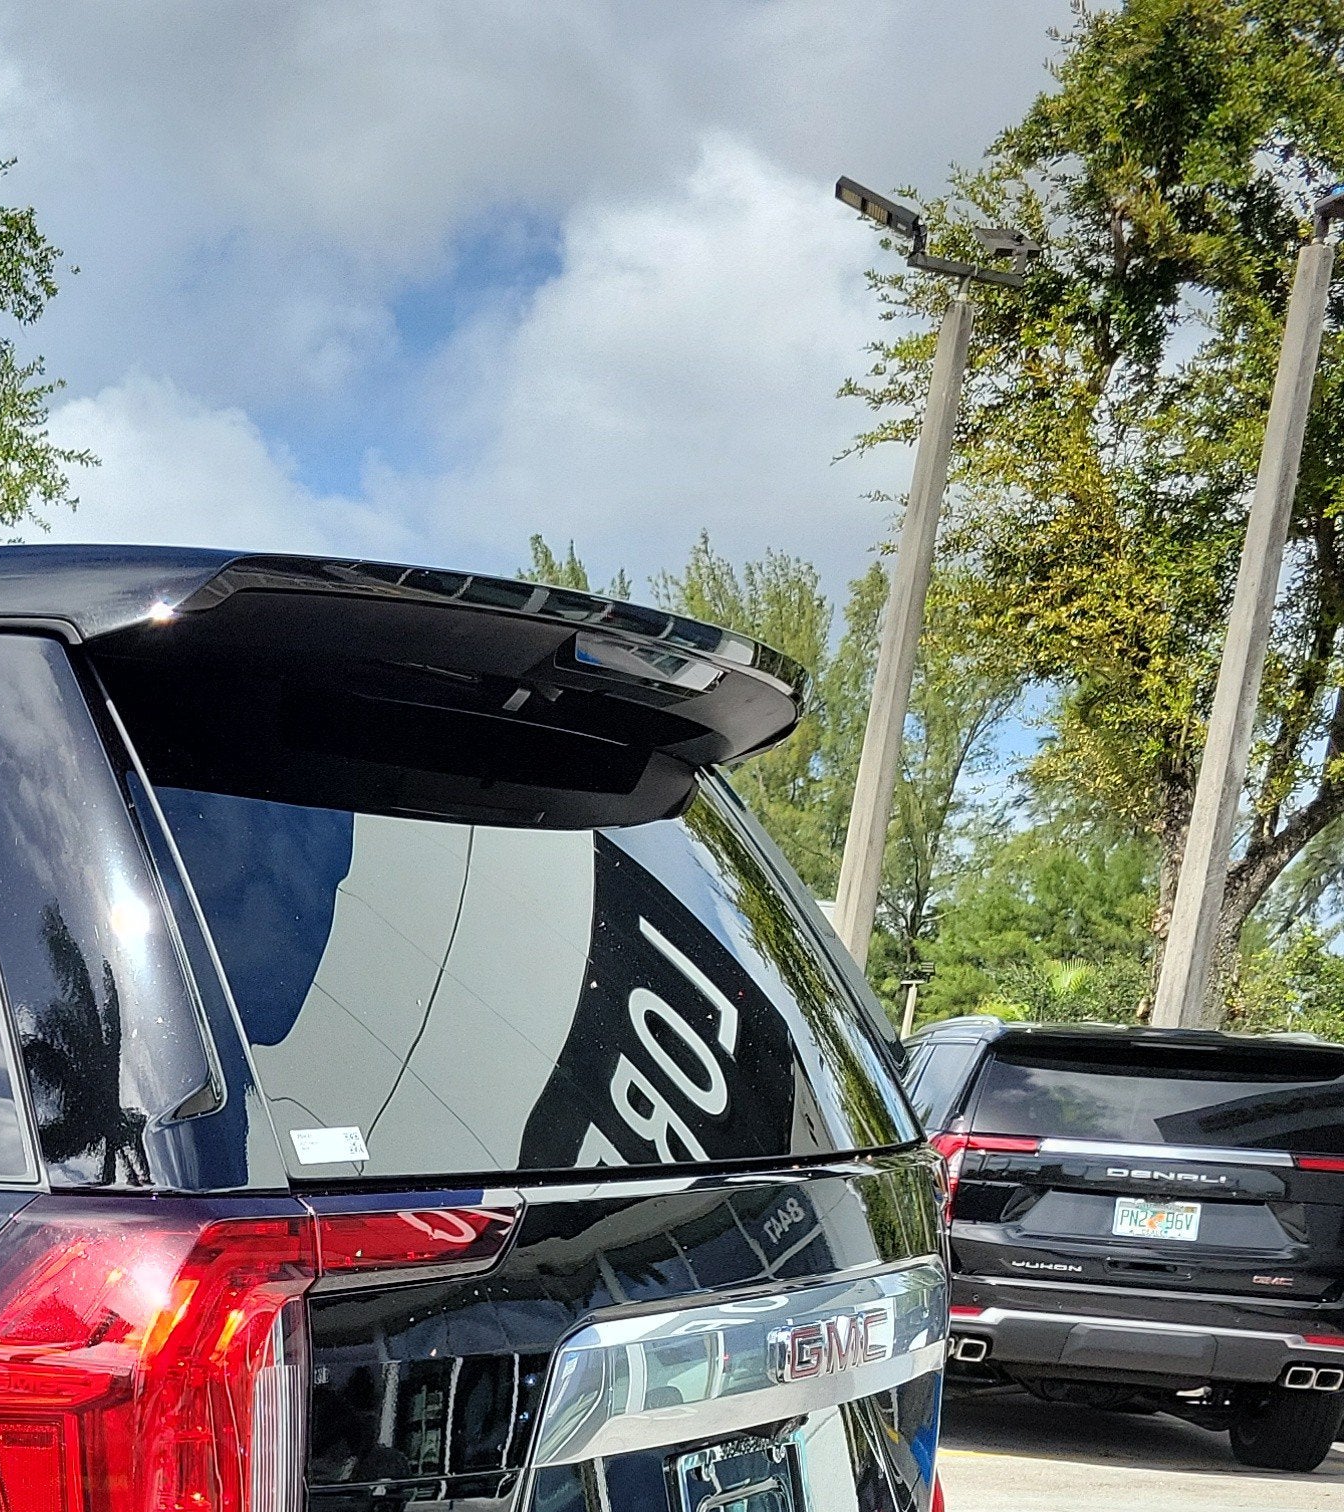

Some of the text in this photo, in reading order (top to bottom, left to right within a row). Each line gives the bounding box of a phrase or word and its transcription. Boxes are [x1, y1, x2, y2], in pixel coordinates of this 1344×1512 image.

[1106, 1167, 1227, 1184] DENALI
[1012, 1260, 1083, 1273] YUKON
[784, 1307, 890, 1382] GMC
